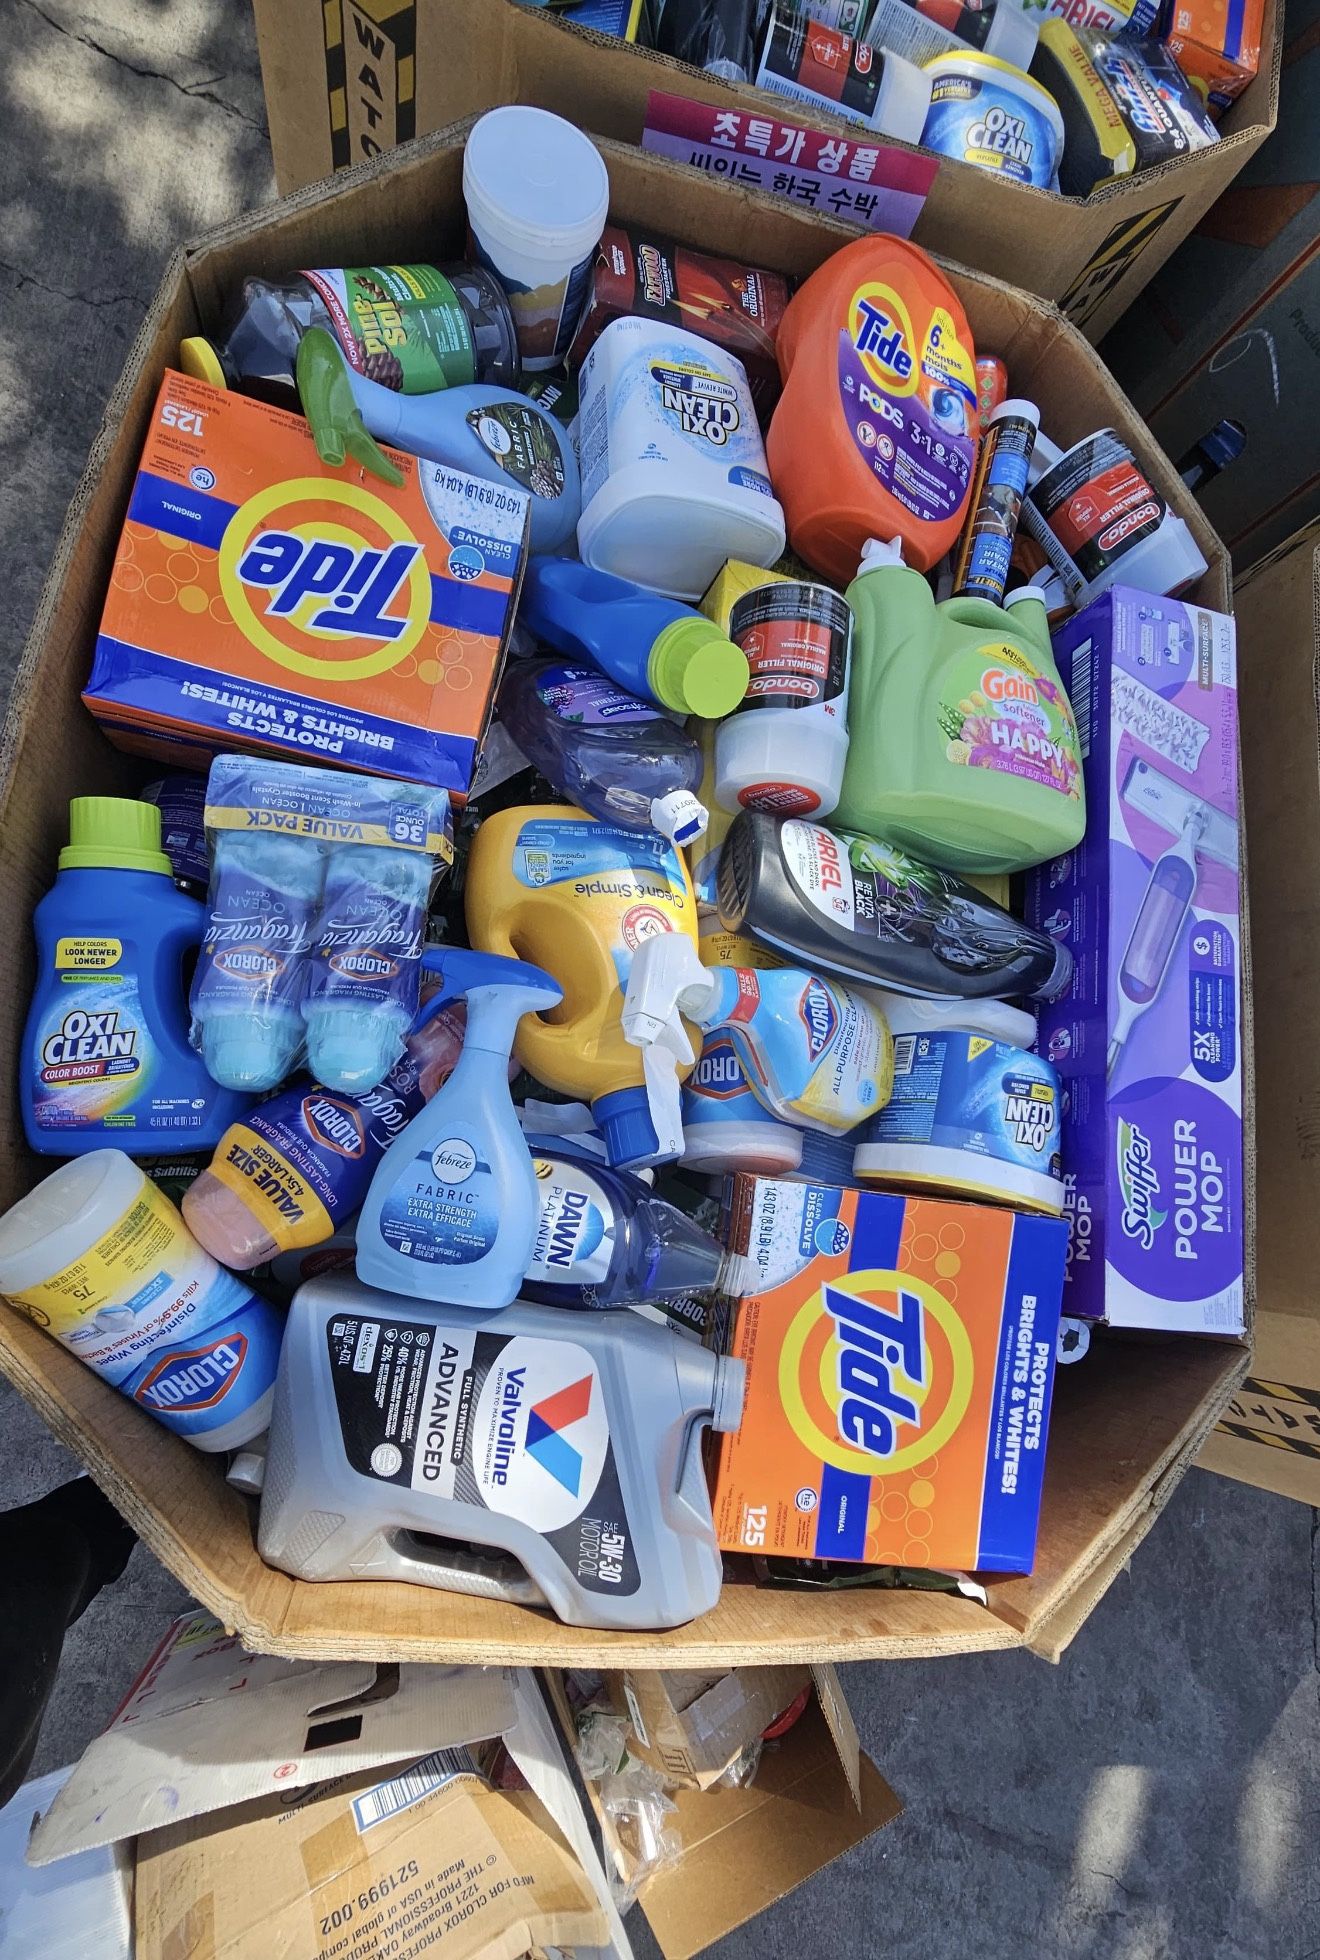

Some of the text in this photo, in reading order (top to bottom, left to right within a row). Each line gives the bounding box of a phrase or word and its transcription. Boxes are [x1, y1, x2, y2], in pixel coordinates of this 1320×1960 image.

[1177, 10, 1190, 31] 125
[1169, 39, 1184, 53] 125
[1069, 45, 1123, 129] MEGA VALUE
[985, 107, 1026, 139] OXI
[711, 111, 880, 183] 초특가 상품
[966, 122, 1034, 165] CLEAN
[827, 187, 880, 221] 수박
[639, 244, 666, 307] FATWOOD
[661, 258, 671, 300] FIRESTARTER
[741, 290, 750, 309] THE
[746, 274, 759, 317] ORIGINAL
[330, 302, 359, 366] NOW 2X MORE
[853, 298, 913, 379] Tide
[925, 354, 949, 372] mois
[925, 364, 950, 385] 100%
[926, 345, 963, 370] months
[160, 403, 204, 437] 125
[662, 385, 740, 432] CLEAN
[859, 383, 904, 430] PODS
[512, 421, 526, 470] FABRIC
[681, 412, 728, 446] OXI
[434, 468, 522, 514] 143 OZ (8.9 LB) 4.04 kg
[161, 500, 202, 521] ORIGINAL
[1099, 504, 1124, 524] FILLER
[1108, 504, 1157, 543] bondo
[457, 530, 513, 553] DISSOLVE
[485, 547, 511, 560] CLEAN
[236, 529, 425, 643] Tide
[757, 658, 825, 674] ORIGINAL FILLER
[1202, 618, 1210, 687] MULTI-SURFACE
[752, 679, 815, 694] bondo
[981, 668, 1039, 706] Gain
[180, 680, 395, 752] BRIGHTS & WHITES!
[823, 704, 836, 717] 3M
[1003, 702, 1045, 727] softener
[226, 711, 344, 756] PROTECTS
[991, 722, 1065, 768] HAPPY
[251, 786, 281, 796] Crystals
[282, 789, 311, 800] Booster
[311, 793, 331, 804] Scent
[246, 810, 364, 840] VALUE PACK
[395, 813, 425, 825] OUNCE
[397, 806, 426, 818] TOTAL
[393, 823, 424, 844] 36
[813, 829, 842, 892] ARIEL
[228, 895, 286, 914] OCEAN
[575, 882, 685, 910] Clean & Simple
[853, 879, 865, 916] BLACK
[863, 883, 875, 919] REVITA
[65, 948, 117, 957] LOOK NEWER
[319, 919, 423, 960] Fraganzia
[719, 950, 732, 961] 75
[74, 957, 106, 966] LONGER
[223, 953, 278, 972] CLOROX
[338, 955, 392, 974] CLOROX
[61, 1010, 119, 1041] OXI
[809, 985, 829, 1053] CLOROX
[42, 1031, 136, 1067] CLEAN
[832, 1023, 855, 1096] ALL PURPOSE
[1193, 1030, 1211, 1062] 5X
[44, 1063, 100, 1081] COLOR BOOST
[307, 1099, 362, 1153] CLOROX
[1005, 1096, 1053, 1133] CLEAN
[1016, 1122, 1046, 1152] OXI
[152, 1165, 199, 1178] Subtilis
[288, 1146, 338, 1207] LONG-LASTING
[436, 1150, 473, 1172] febreze
[225, 1143, 305, 1225] VALUE SIZE
[285, 1175, 306, 1197] 4.5x
[415, 1183, 474, 1204] FABRIC
[1121, 1123, 1153, 1251] Swiffer
[1174, 1119, 1198, 1260] POWER
[1200, 1150, 1225, 1233] MOP
[407, 1197, 478, 1220] EXTRA STRENGTH
[407, 1207, 473, 1229] EXTRA EFFICACE
[756, 1186, 778, 1247] 143 OZ (8.9 LB)
[802, 1191, 818, 1250] DISSOLVE
[815, 1192, 825, 1220] CLEAN
[532, 1185, 562, 1264] PLATINUM
[545, 1189, 589, 1269] DAWN
[1075, 1195, 1092, 1262] MOP
[73, 1287, 96, 1302] 75
[181, 1280, 200, 1300] Kills
[151, 1296, 185, 1328] 99.9%
[95, 1302, 196, 1368] Disinfecting Wipes
[380, 1344, 394, 1362] 25%
[396, 1346, 410, 1367] 40%
[821, 1280, 928, 1460] Tide
[141, 1343, 240, 1408] CLOROX
[494, 1367, 505, 1395] PROVEN
[423, 1341, 459, 1482] ADVANCED
[1001, 1294, 1037, 1495] BRIGHTS & WHITES!
[1024, 1342, 1050, 1451] PROTECTS
[453, 1375, 473, 1460] FULL SYNTHETIC
[488, 1407, 499, 1442] MAXIMIZE
[492, 1366, 527, 1486] Valvoline
[484, 1443, 493, 1469] ENGINE
[602, 1520, 620, 1534] SAE
[745, 1504, 768, 1547] 125
[836, 1495, 849, 1534] ORIGINAL
[577, 1517, 602, 1578] MOTOR OIL
[598, 1532, 627, 1584] 5W-30
[319, 1859, 420, 1936] 521999.002
[352, 1858, 466, 1940] Made in USA of global
[380, 1862, 485, 1939] THE PROFESSIONAL
[401, 1883, 480, 1943] 1221 Broadway
[443, 1874, 536, 1928] MFD FOR CLOROX
